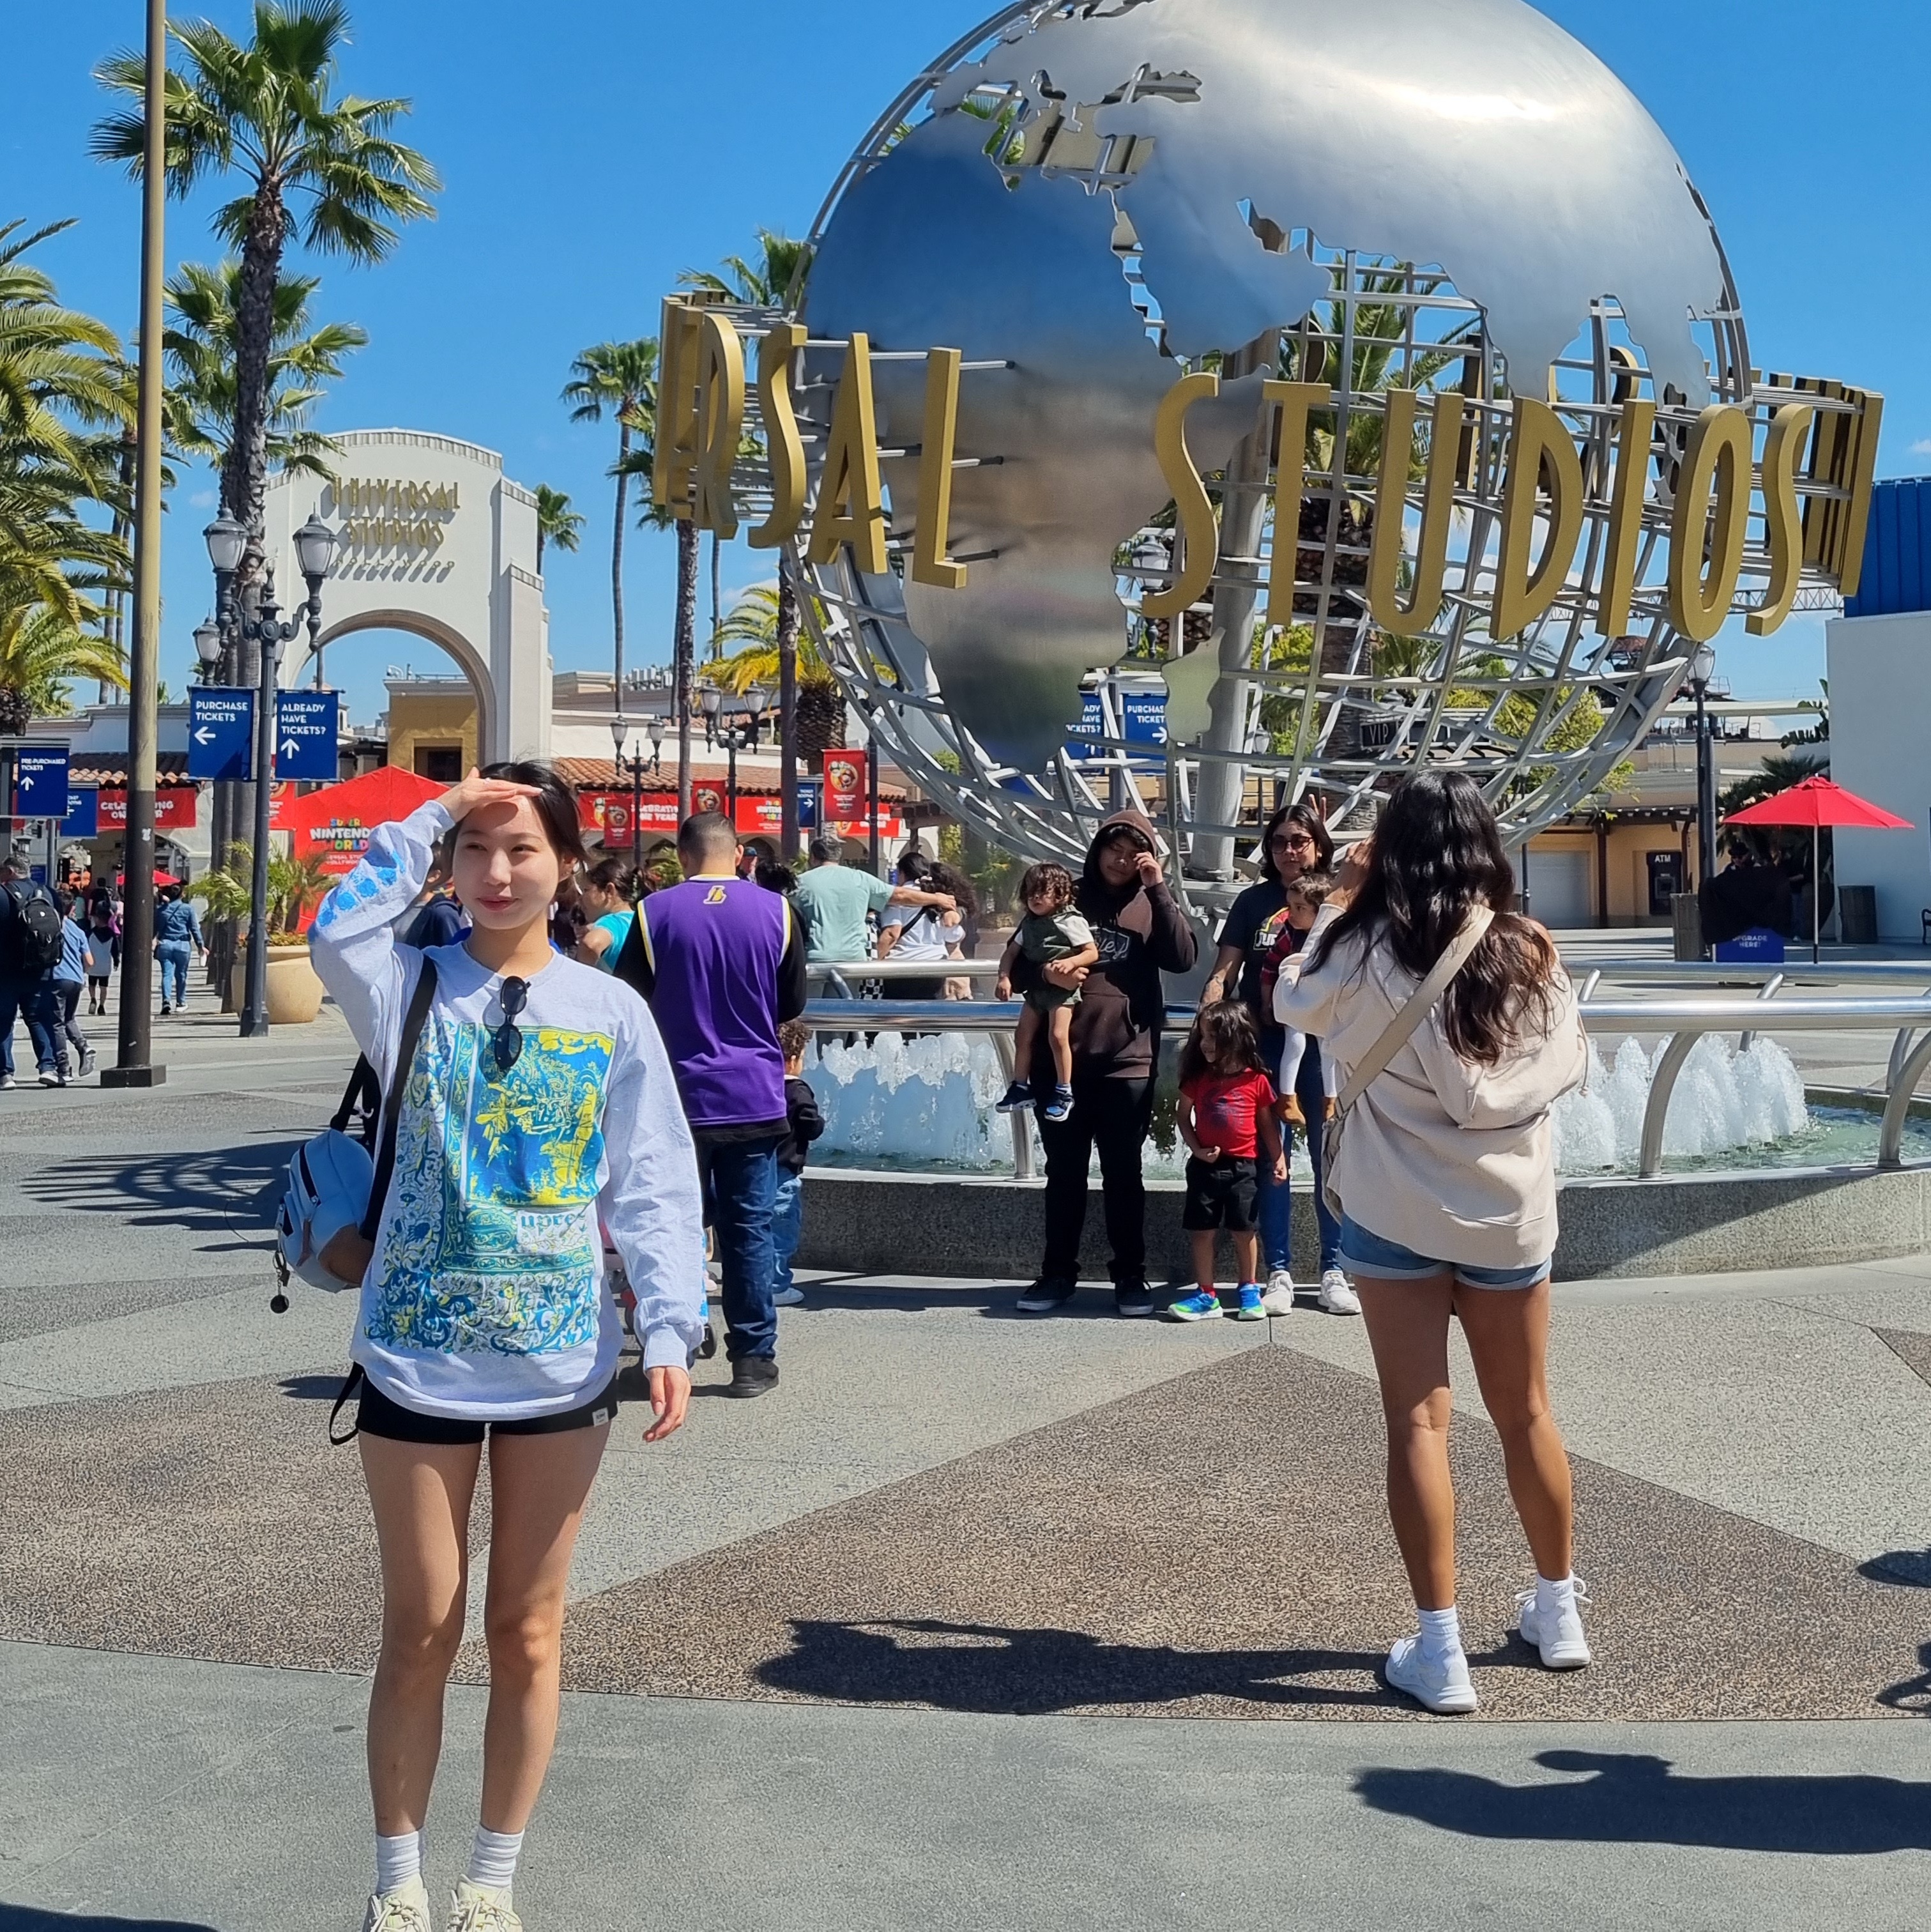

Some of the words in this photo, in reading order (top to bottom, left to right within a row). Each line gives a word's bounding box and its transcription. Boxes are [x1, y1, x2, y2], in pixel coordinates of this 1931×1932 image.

[332, 477, 461, 509] UNIVERSAL
[1141, 372, 1813, 642] STUDIOS
[348, 516, 444, 548] STUDIOS
[195, 701, 248, 710] PURCHASE
[281, 703, 326, 712] ALREADY
[1127, 705, 1164, 713] PURCHAS
[195, 712, 236, 721] TICKETS
[281, 715, 307, 723] HAVE
[281, 726, 326, 734] TICKETS?
[1369, 723, 1389, 744] VIP
[100, 801, 174, 810] CELEING
[330, 818, 362, 827] SUER
[309, 827, 371, 840] NINTEND
[333, 839, 369, 850] ORLD
[1654, 854, 1671, 862] ATM
